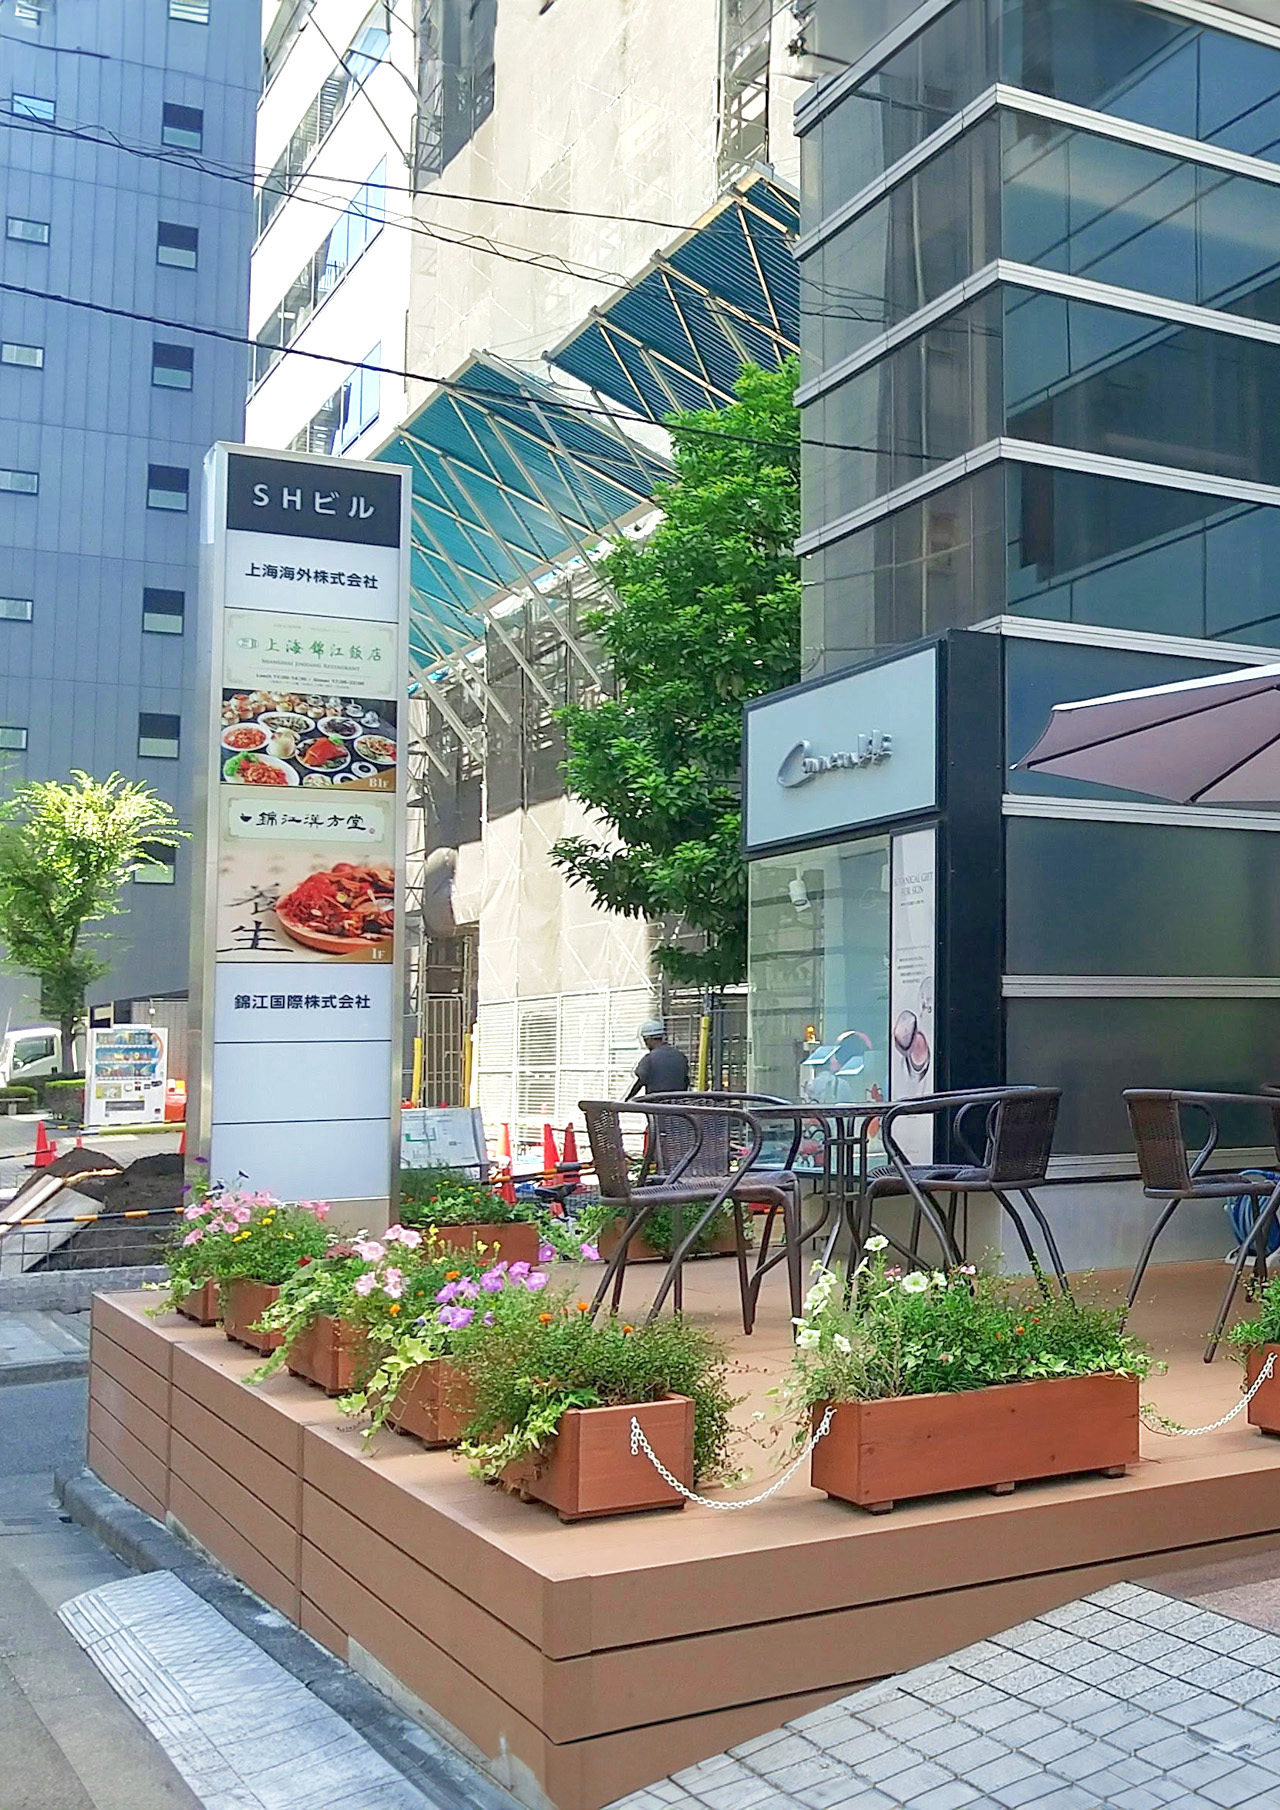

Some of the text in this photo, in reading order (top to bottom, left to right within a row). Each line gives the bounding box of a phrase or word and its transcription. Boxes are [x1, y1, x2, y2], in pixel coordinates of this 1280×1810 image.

[253, 483, 375, 519] SHビル
[245, 562, 379, 590] 上海海外株式会社
[265, 637, 382, 662] 上海錦江飯店
[256, 811, 367, 831] 錦江漢方堂
[234, 994, 371, 1010] 錦江国際株式会社
